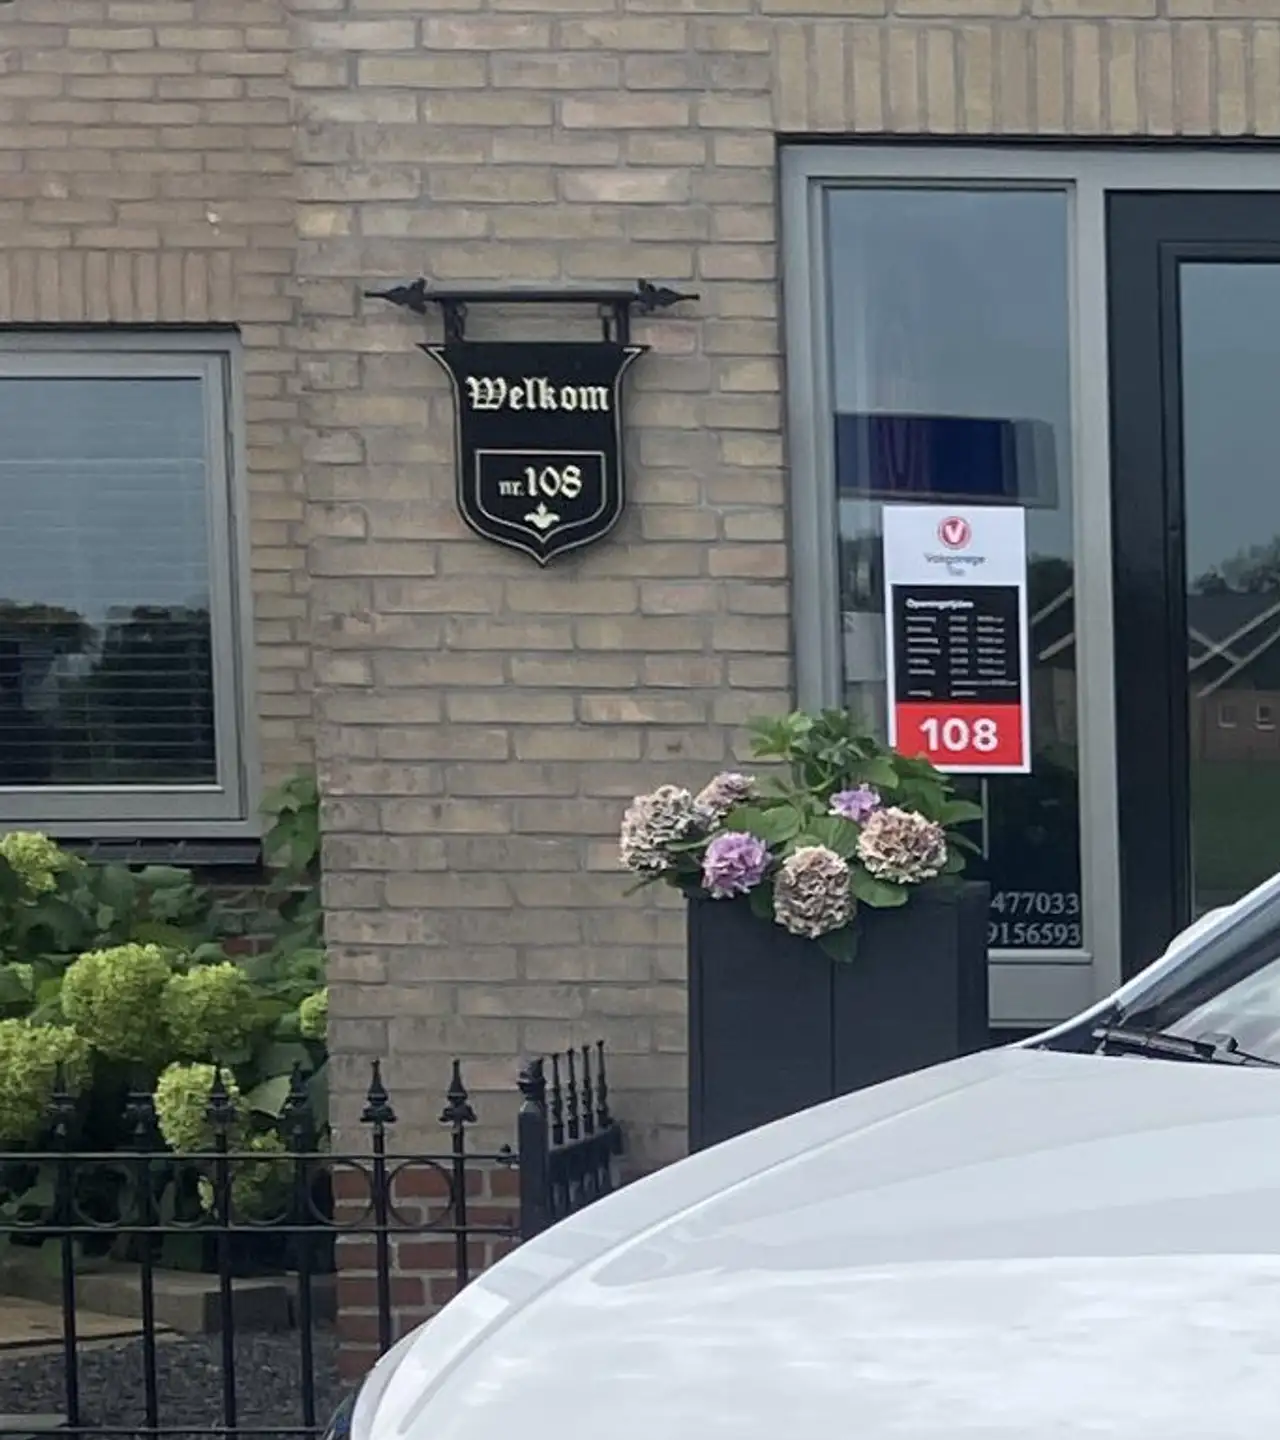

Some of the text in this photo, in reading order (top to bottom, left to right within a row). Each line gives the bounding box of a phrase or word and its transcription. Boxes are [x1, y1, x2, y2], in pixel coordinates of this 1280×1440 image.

[466, 376, 609, 411] Welkom
[919, 717, 999, 752] 108
[989, 891, 1080, 915] 477033
